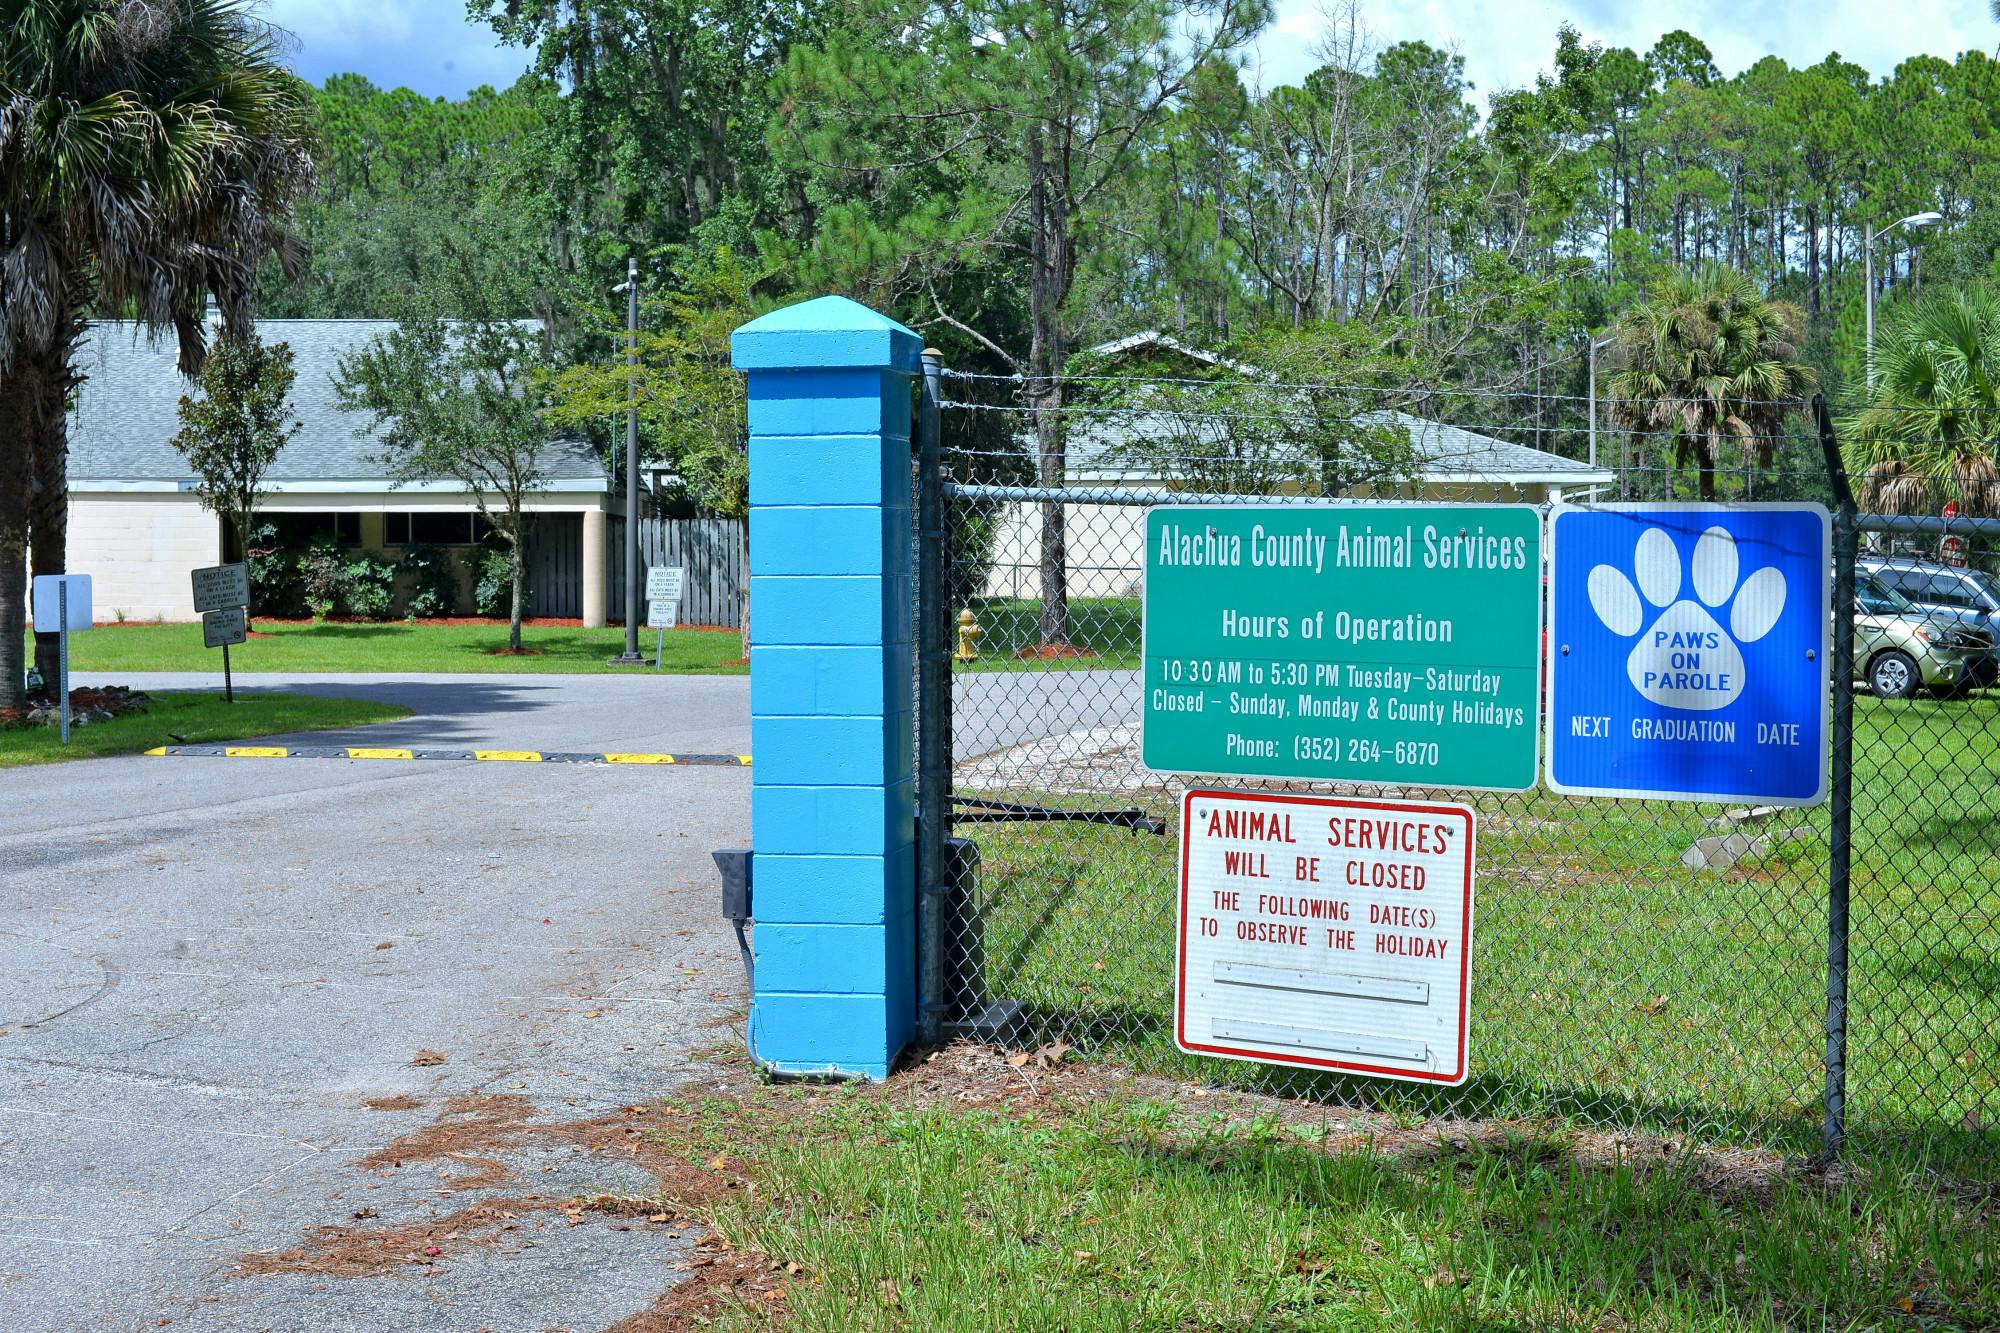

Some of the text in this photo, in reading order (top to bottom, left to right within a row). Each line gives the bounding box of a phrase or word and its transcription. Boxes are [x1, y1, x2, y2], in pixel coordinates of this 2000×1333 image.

[1159, 524, 1526, 574] Alachua County Animal Services
[202, 569, 237, 580] NOTICE
[1222, 609, 1452, 645] Hours of Operation
[1654, 630, 1720, 650] PAWS
[1216, 661, 1241, 684] AM
[1248, 663, 1264, 685] to
[1271, 662, 1308, 686] 5:30
[1315, 663, 1339, 687] PM
[1670, 652, 1701, 671] ON
[1643, 671, 1732, 692] PAROLE
[1153, 688, 1204, 713] Closed
[1229, 691, 1290, 719] Sunday,
[1298, 694, 1360, 722] Monday
[1367, 699, 1380, 721] &
[1387, 697, 1445, 726] County
[1452, 700, 1524, 729] Holidays
[1571, 715, 1801, 746] NEXT GRADUATION DATE
[1226, 733, 1439, 766] Phone: (352) 264-6870
[1207, 808, 1449, 855] ANIMAL SERVICES
[1224, 851, 1427, 891] WILL BE CLOSED
[1212, 890, 1437, 929] THE FOLLOWING DATE(S)
[1199, 917, 1449, 960] TO OBSERVE THE HOLIDAY
